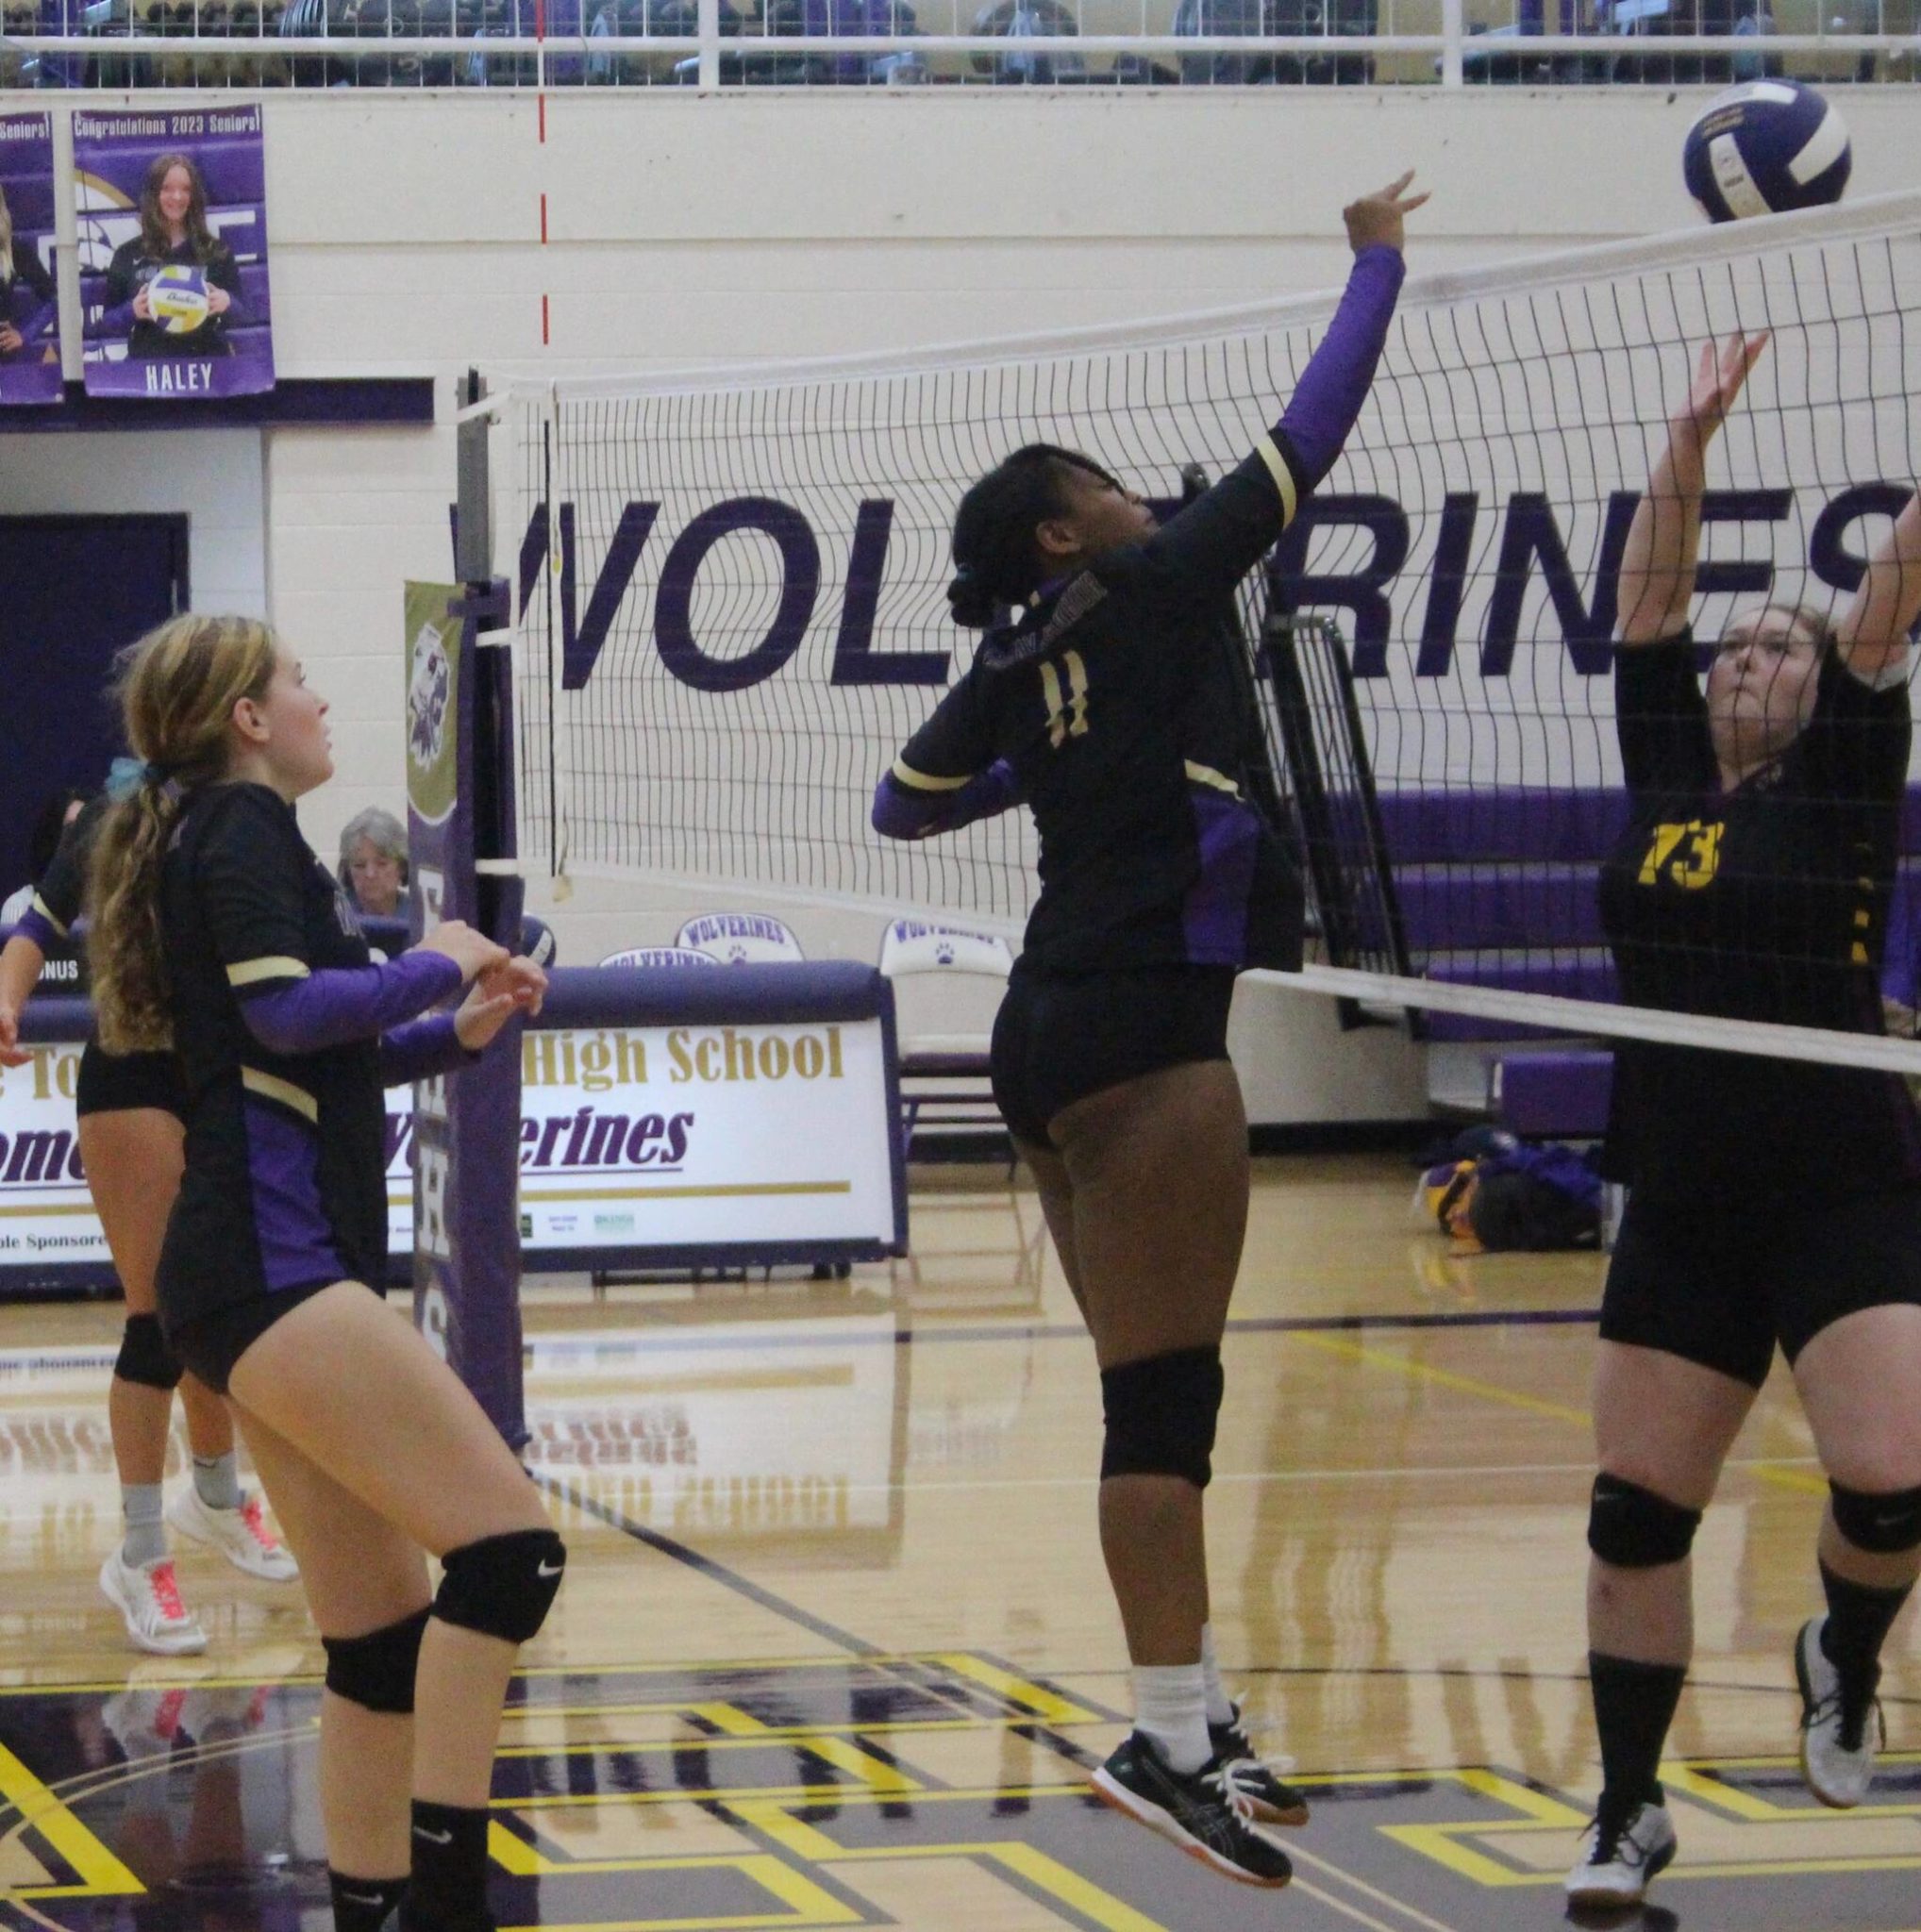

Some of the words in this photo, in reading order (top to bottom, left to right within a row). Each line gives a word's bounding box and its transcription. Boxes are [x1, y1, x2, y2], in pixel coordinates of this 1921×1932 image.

[74, 117, 166, 139] Congratulations
[172, 116, 204, 134] 2023
[145, 362, 212, 391] HALEY
[1038, 649, 1089, 749] 11
[1638, 819, 1725, 889] 73
[686, 915, 785, 944] WOLVERINES
[521, 1027, 649, 1092] High
[669, 1025, 844, 1085] School
